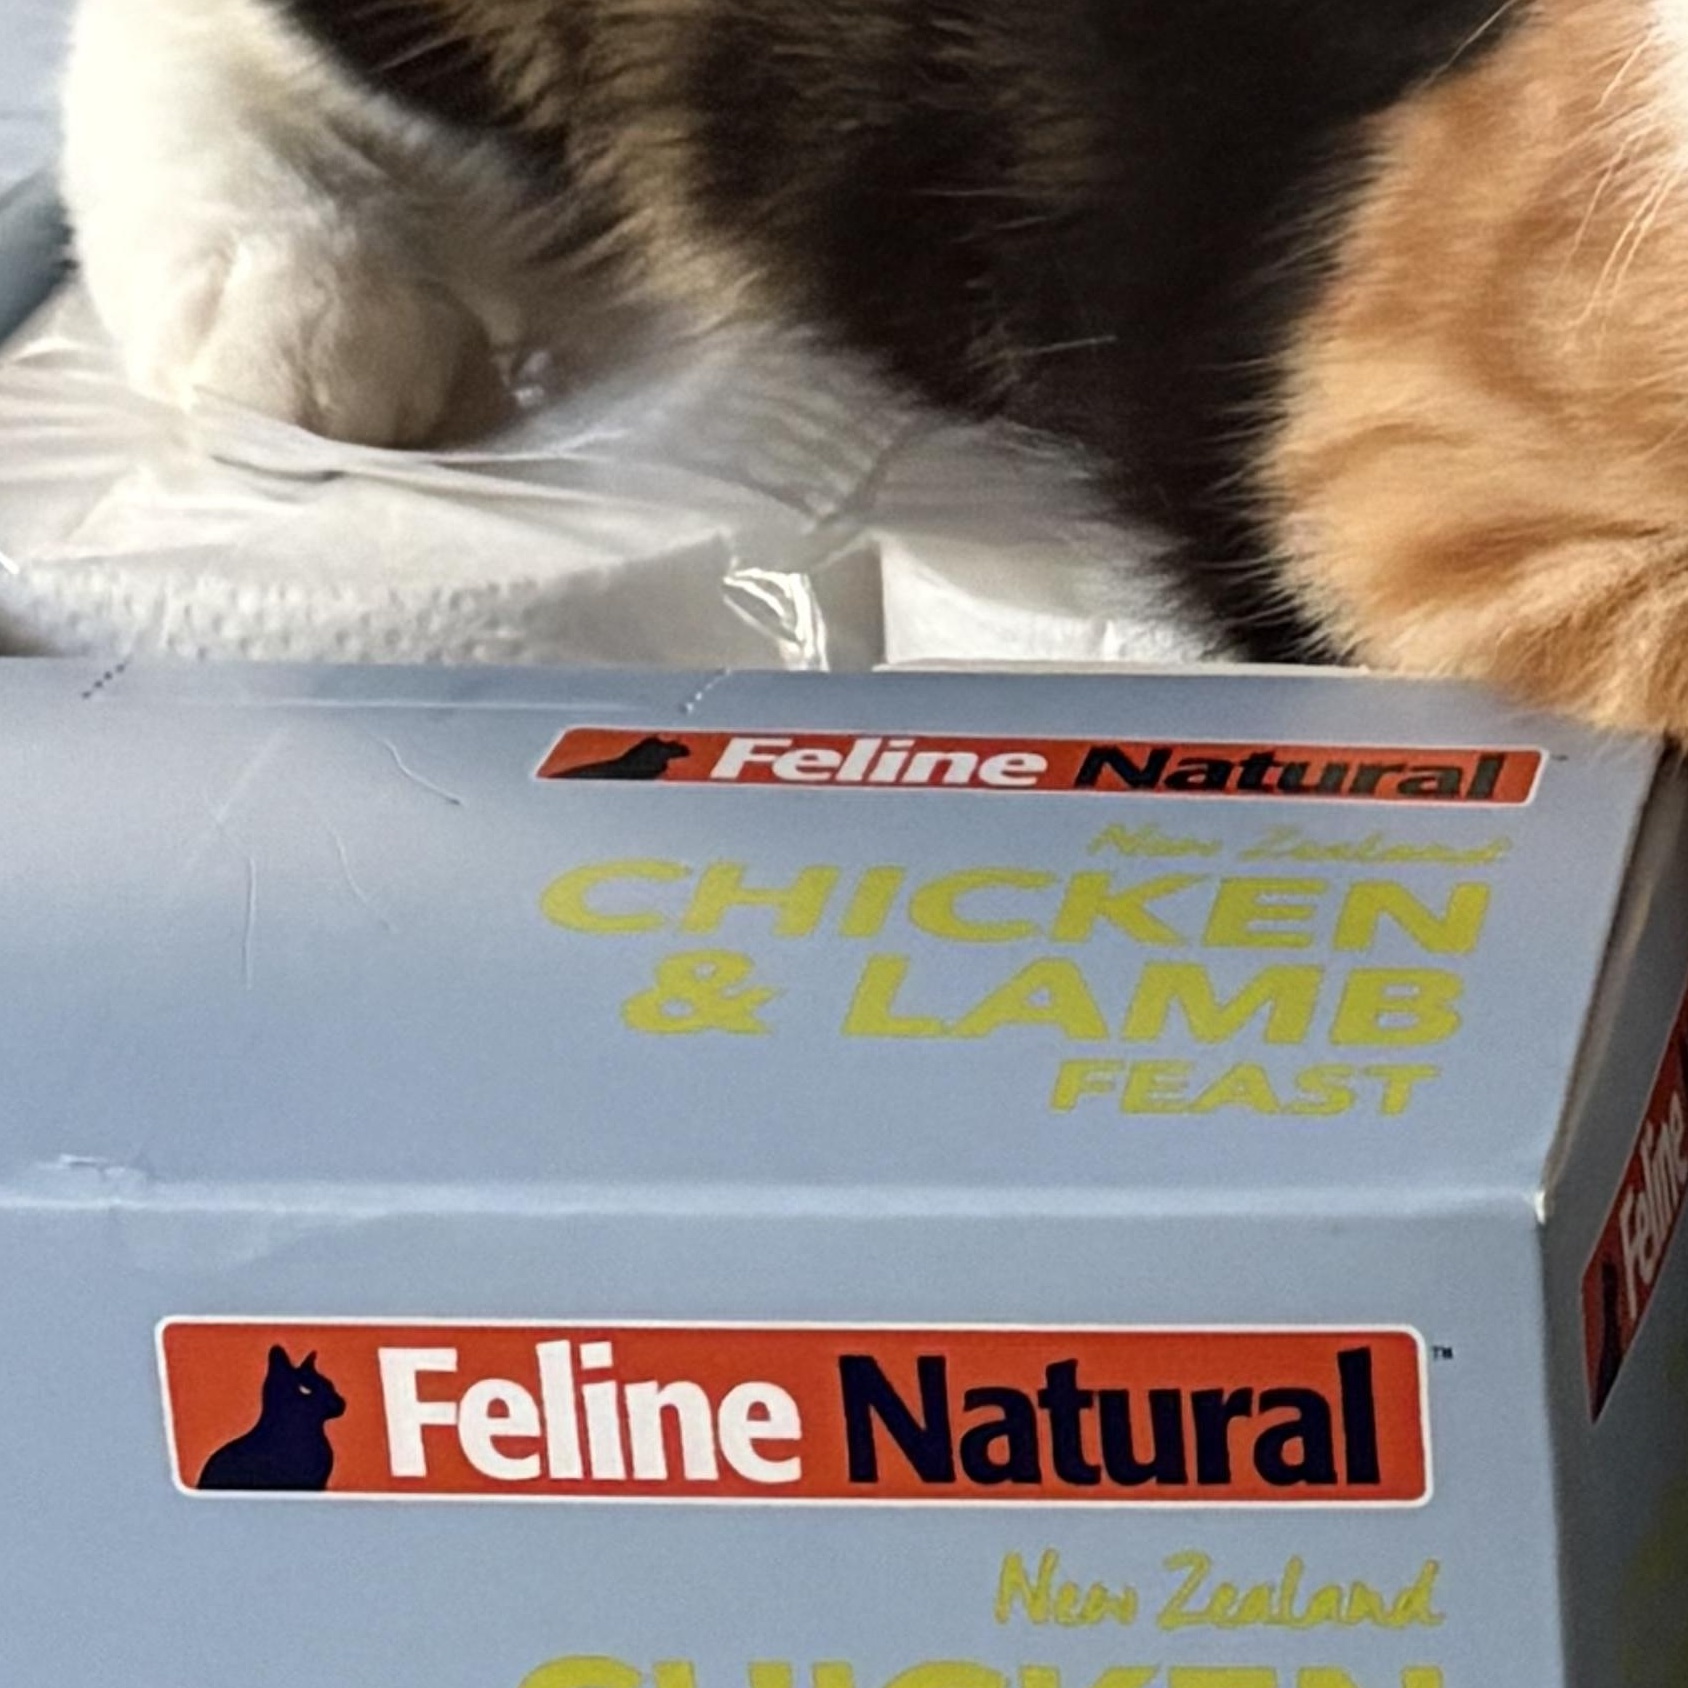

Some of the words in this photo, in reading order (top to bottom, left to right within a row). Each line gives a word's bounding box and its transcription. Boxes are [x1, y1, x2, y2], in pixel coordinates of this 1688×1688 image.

[708, 735, 1048, 788] Feline
[1073, 744, 1503, 803] Natural
[538, 857, 1492, 955] CHICKEN
[620, 947, 787, 1035] &
[840, 952, 1465, 1048] LAMB
[1049, 1057, 1441, 1116] FEAST
[1619, 1090, 1688, 1324] Feline
[377, 1338, 802, 1482] Feline
[837, 1345, 1381, 1487] Natural
[993, 1548, 1139, 1627] New
[1156, 1550, 1447, 1630] Zealand
